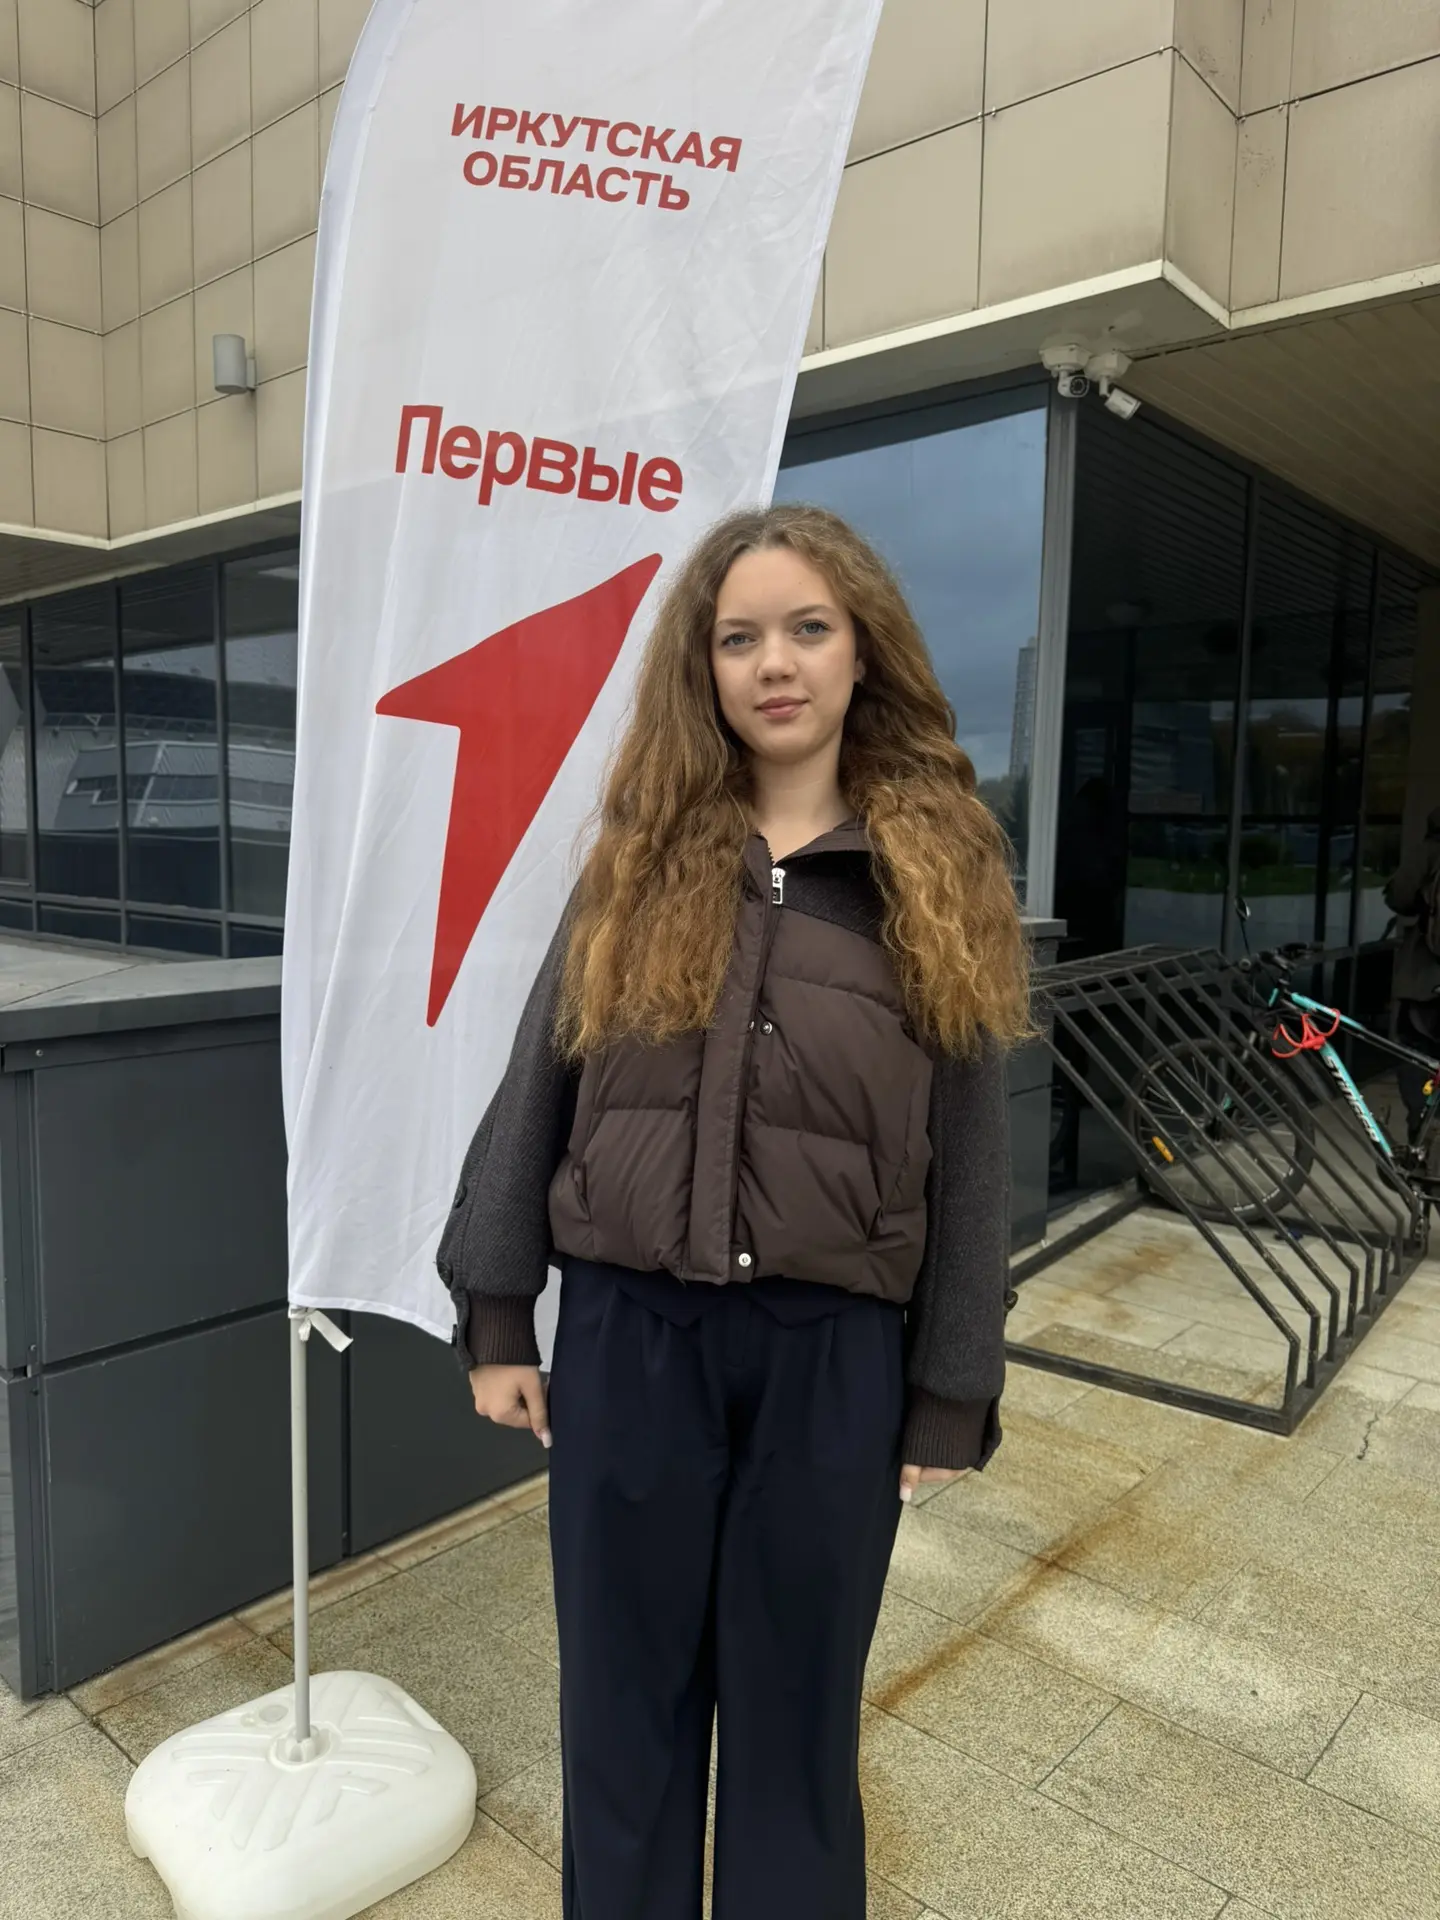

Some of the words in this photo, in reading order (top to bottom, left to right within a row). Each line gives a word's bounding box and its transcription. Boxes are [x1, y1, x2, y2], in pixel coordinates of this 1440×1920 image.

[451, 103, 742, 172] ИРКУТСКАЯ
[463, 151, 690, 211] ОБЛАСТЬ
[395, 405, 683, 512] Первые
